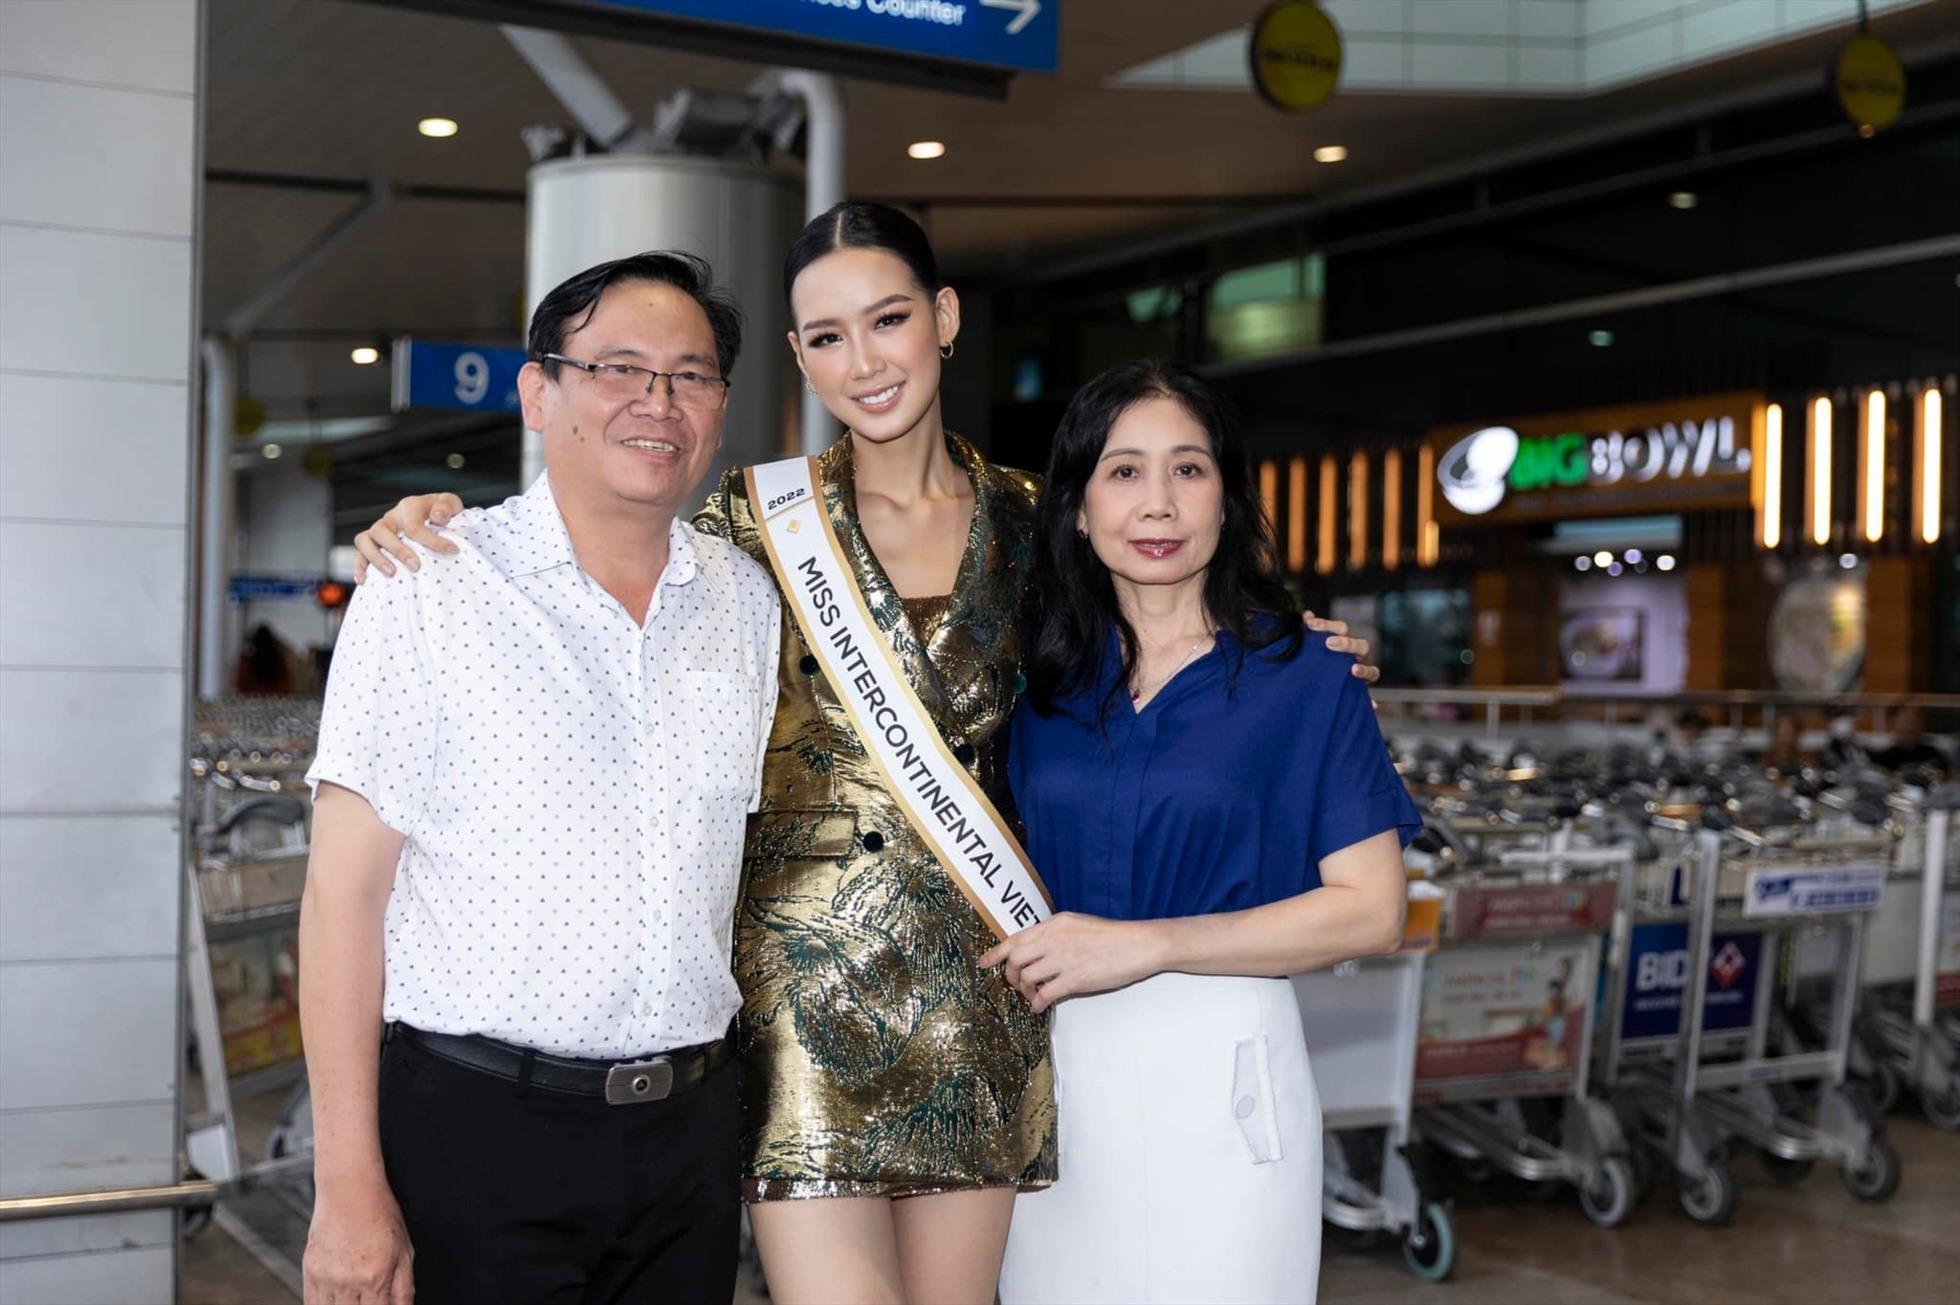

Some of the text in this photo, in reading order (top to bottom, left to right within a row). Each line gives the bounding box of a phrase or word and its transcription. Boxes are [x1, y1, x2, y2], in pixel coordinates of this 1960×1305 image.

[866, 0, 966, 25] Counter
[454, 352, 489, 404] 9
[768, 488, 805, 510] 2022
[798, 556, 841, 627] MISS
[830, 626, 1002, 888] INTERCONTINENTAL
[1636, 950, 1691, 991] BID
